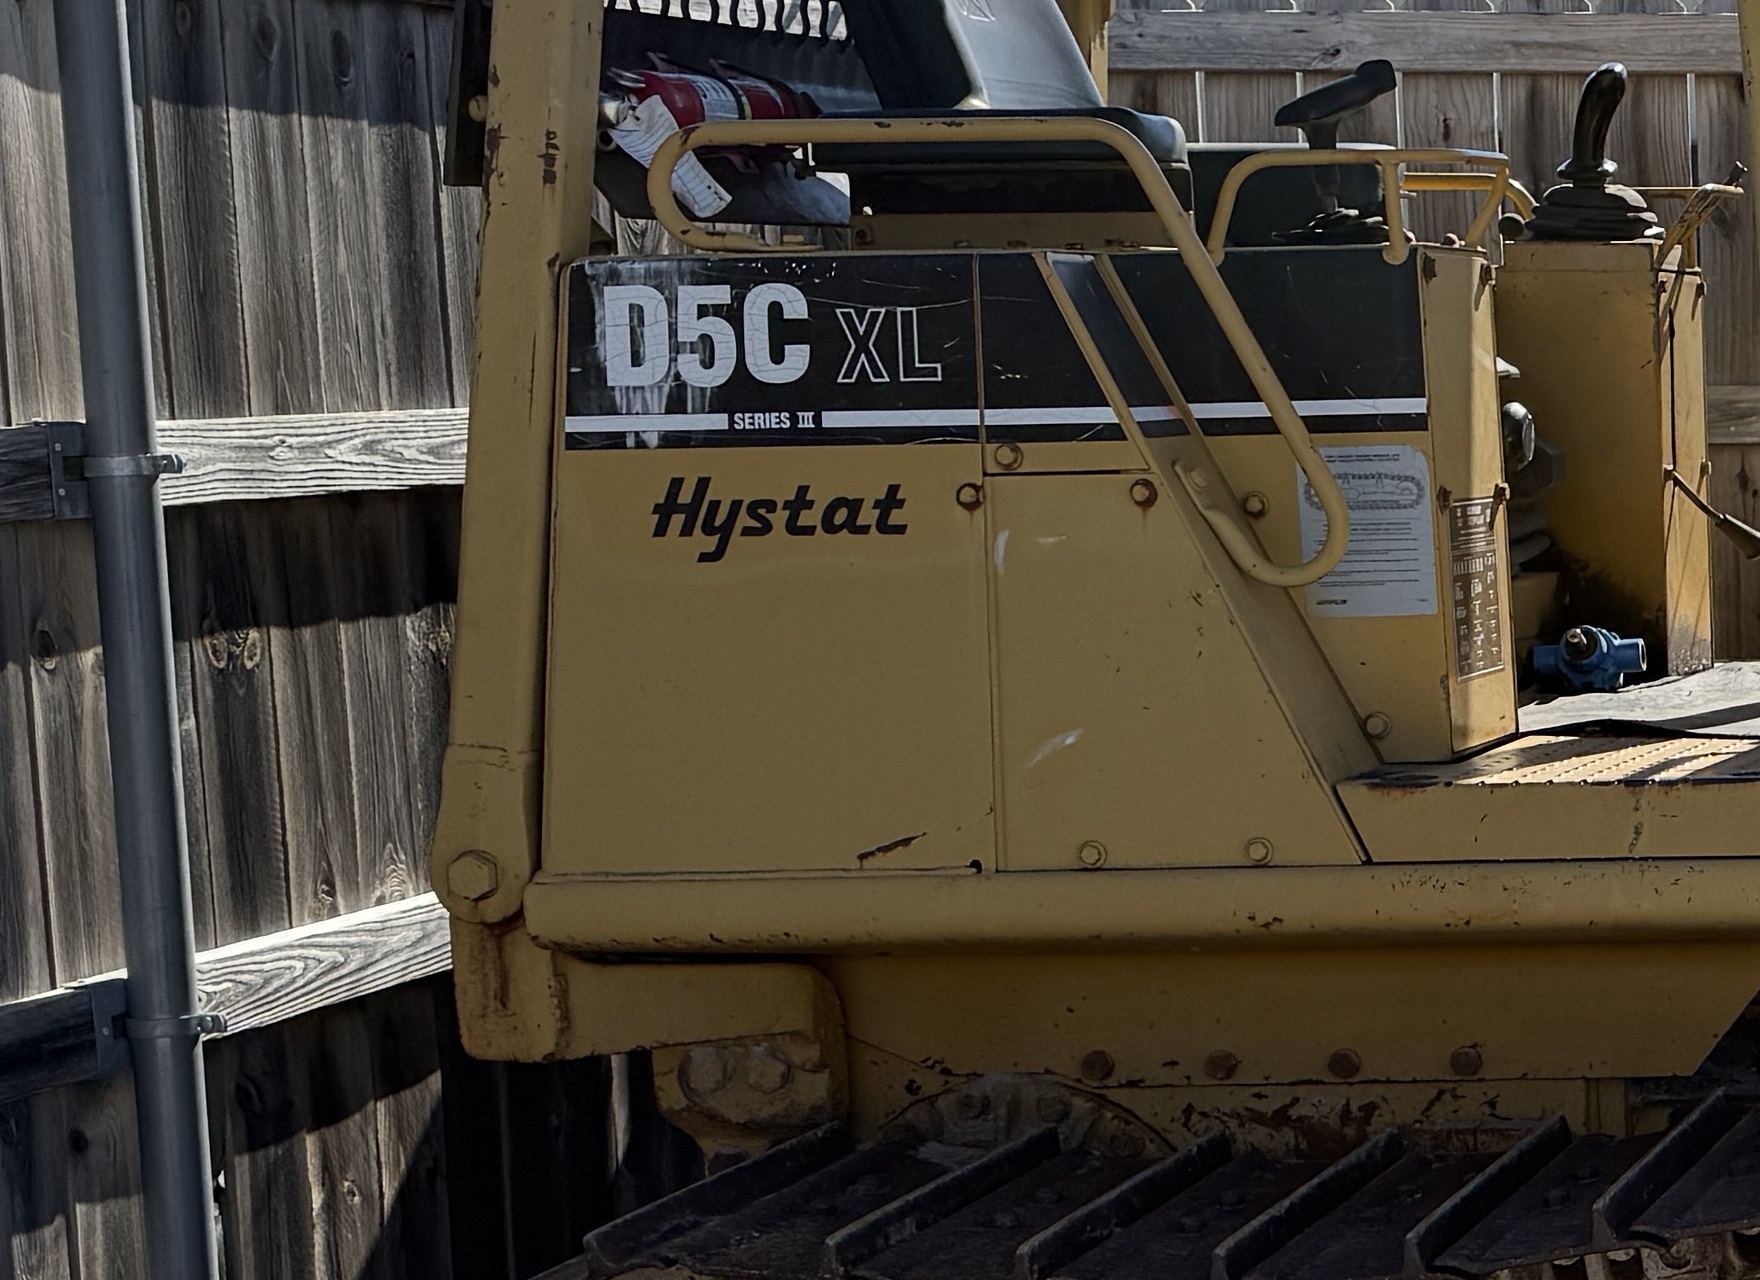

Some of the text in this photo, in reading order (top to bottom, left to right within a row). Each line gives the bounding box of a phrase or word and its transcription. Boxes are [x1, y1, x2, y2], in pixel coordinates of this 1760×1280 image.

[603, 282, 943, 388] D5C XL
[733, 410, 816, 430] SERIES III
[652, 476, 909, 563] Hystat
